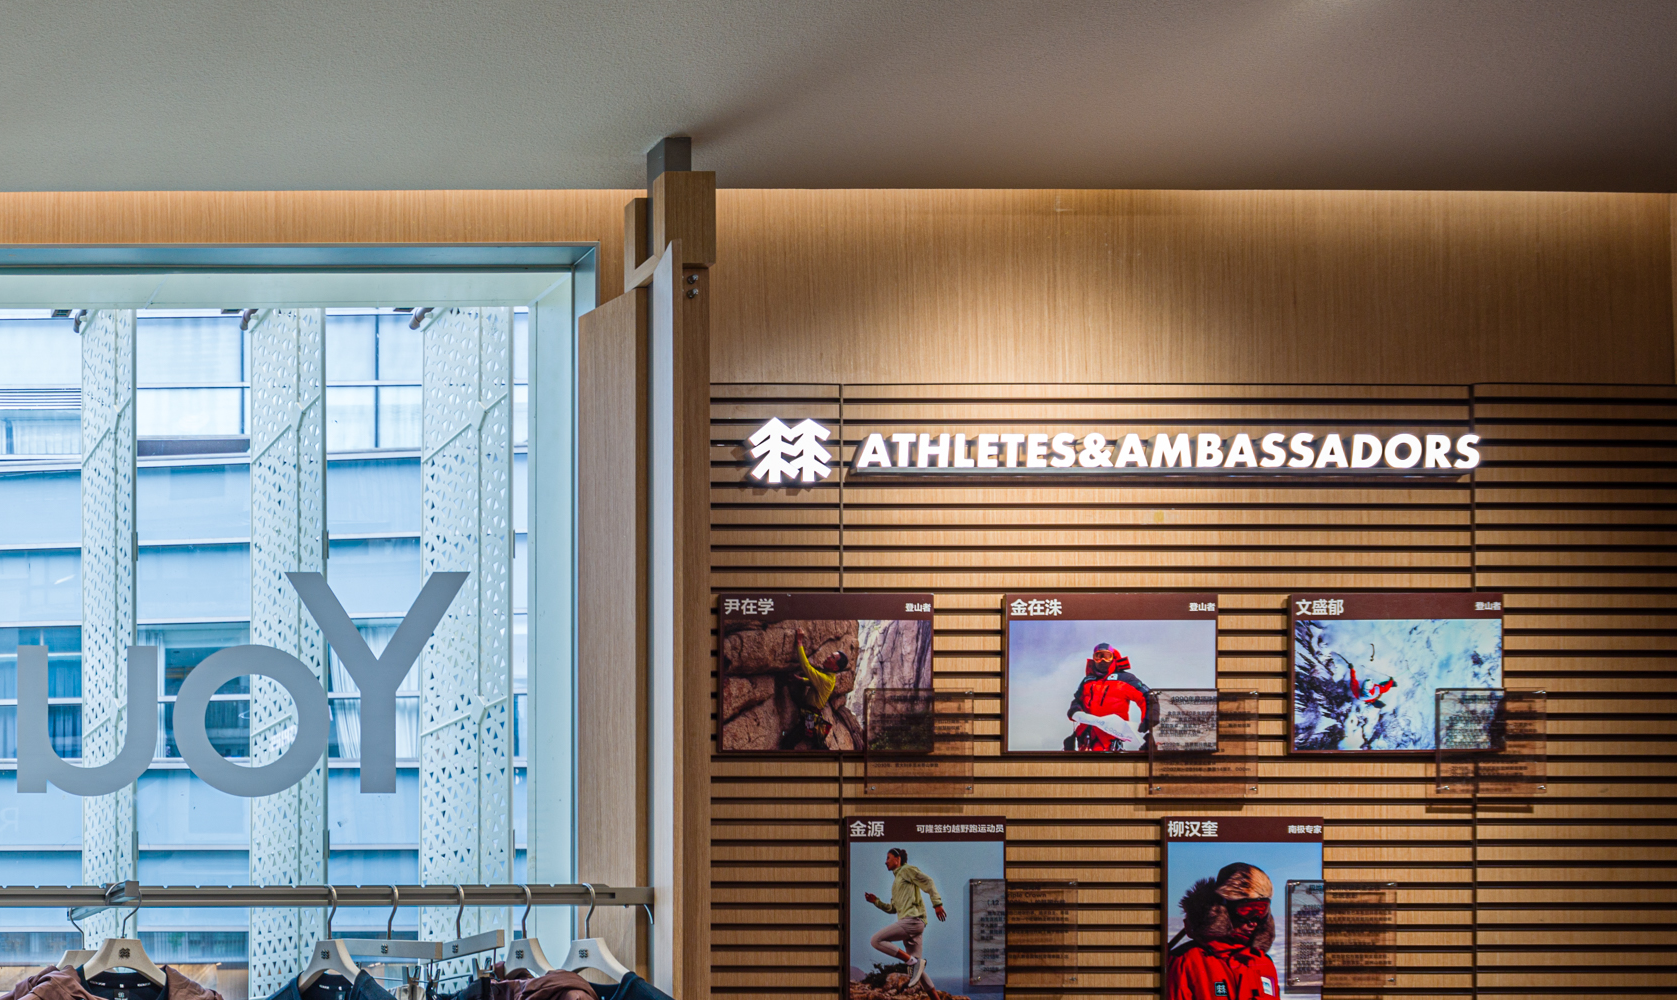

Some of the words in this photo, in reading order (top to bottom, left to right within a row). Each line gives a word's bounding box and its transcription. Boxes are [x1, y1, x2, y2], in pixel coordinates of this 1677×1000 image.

[857, 432, 1481, 469] ATHLETES&AMBASSADORS
[723, 597, 775, 616] 尹在学
[904, 602, 932, 613] 登山者
[1010, 598, 1063, 617] 金在洙
[1188, 602, 1216, 612] 登山者
[1295, 598, 1345, 616] 文盛郁
[1474, 601, 1502, 611] 登山者
[849, 820, 885, 838] 金源
[916, 824, 1005, 834] 可隆签约越野跑运动员
[1167, 820, 1219, 838] 柳汉奎
[1287, 824, 1323, 834] 南极专家
